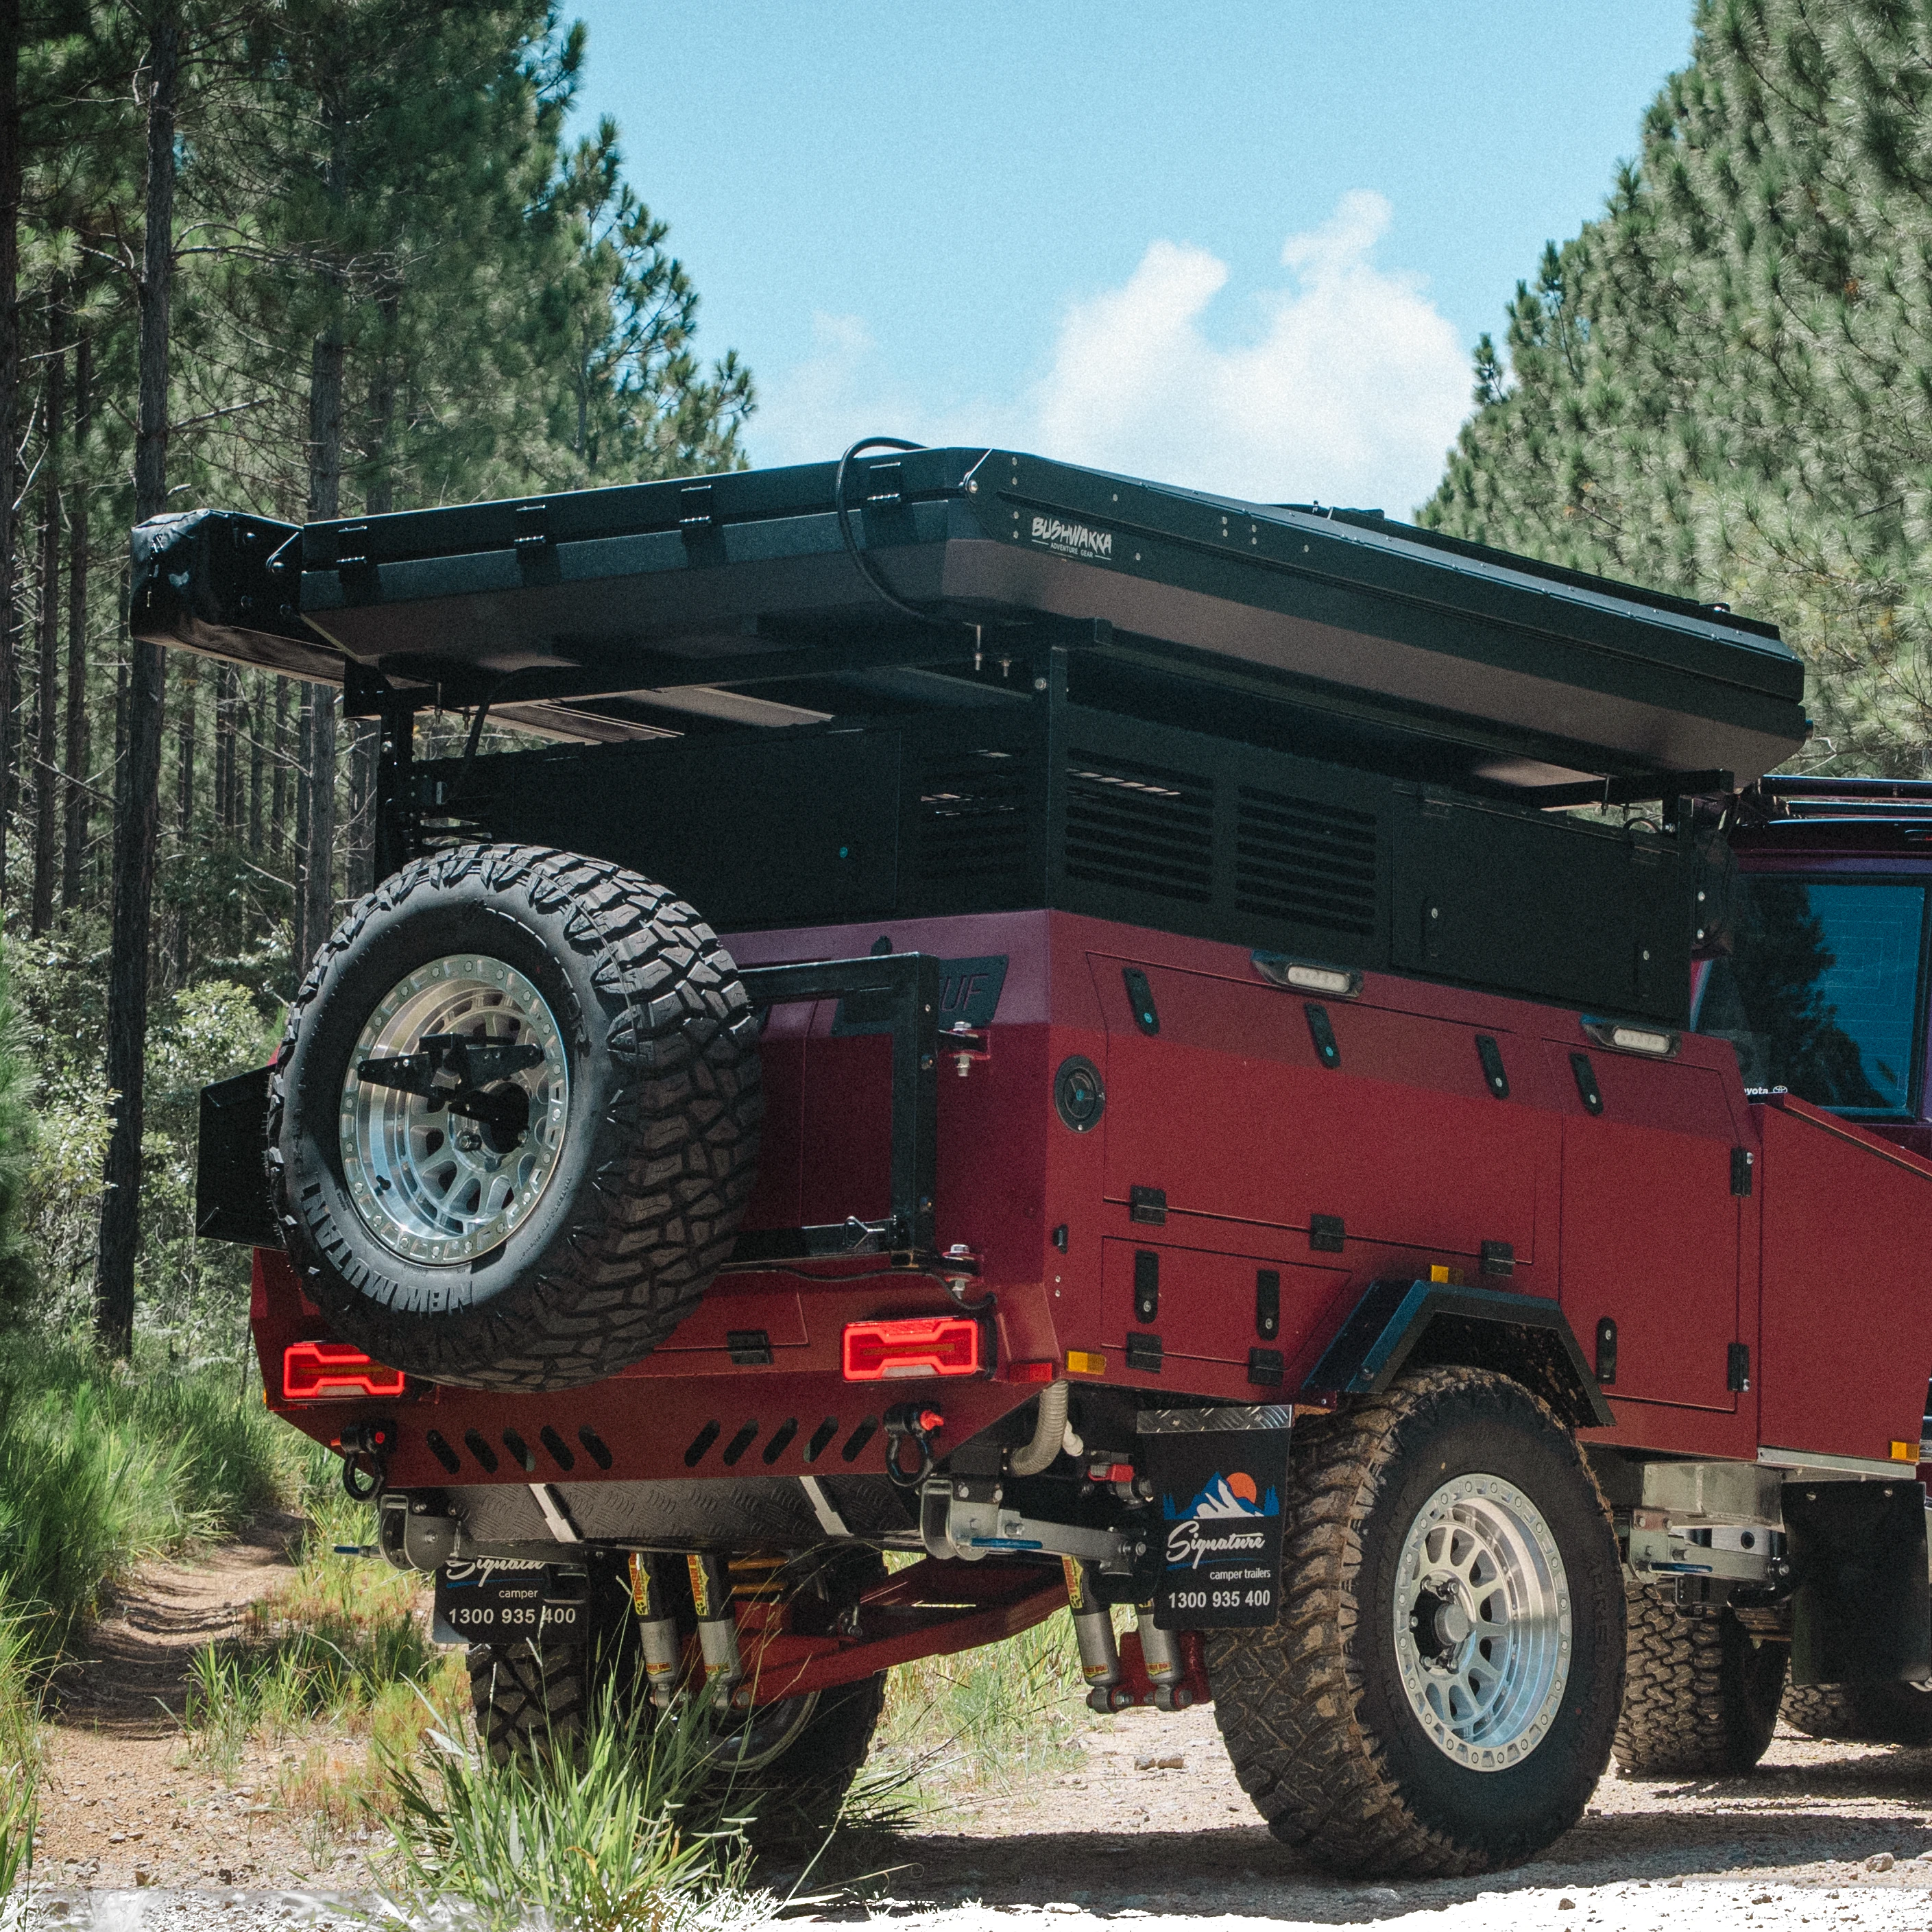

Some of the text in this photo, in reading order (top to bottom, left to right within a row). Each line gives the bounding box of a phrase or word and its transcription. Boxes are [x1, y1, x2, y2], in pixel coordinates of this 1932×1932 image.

[1032, 517, 1112, 555] BUSHWAKKA
[1050, 542, 1094, 559] ADVENTURE GEAR
[939, 973, 989, 1012] UF
[1744, 1087, 1768, 1096] yota
[398, 1280, 473, 1314] NEW
[1166, 1520, 1266, 1570] Signature
[1209, 1567, 1271, 1582] camper trailers
[498, 1590, 538, 1599] camper
[1168, 1589, 1270, 1609] 1300 935 400
[449, 1608, 576, 1624] 1300 935 400
